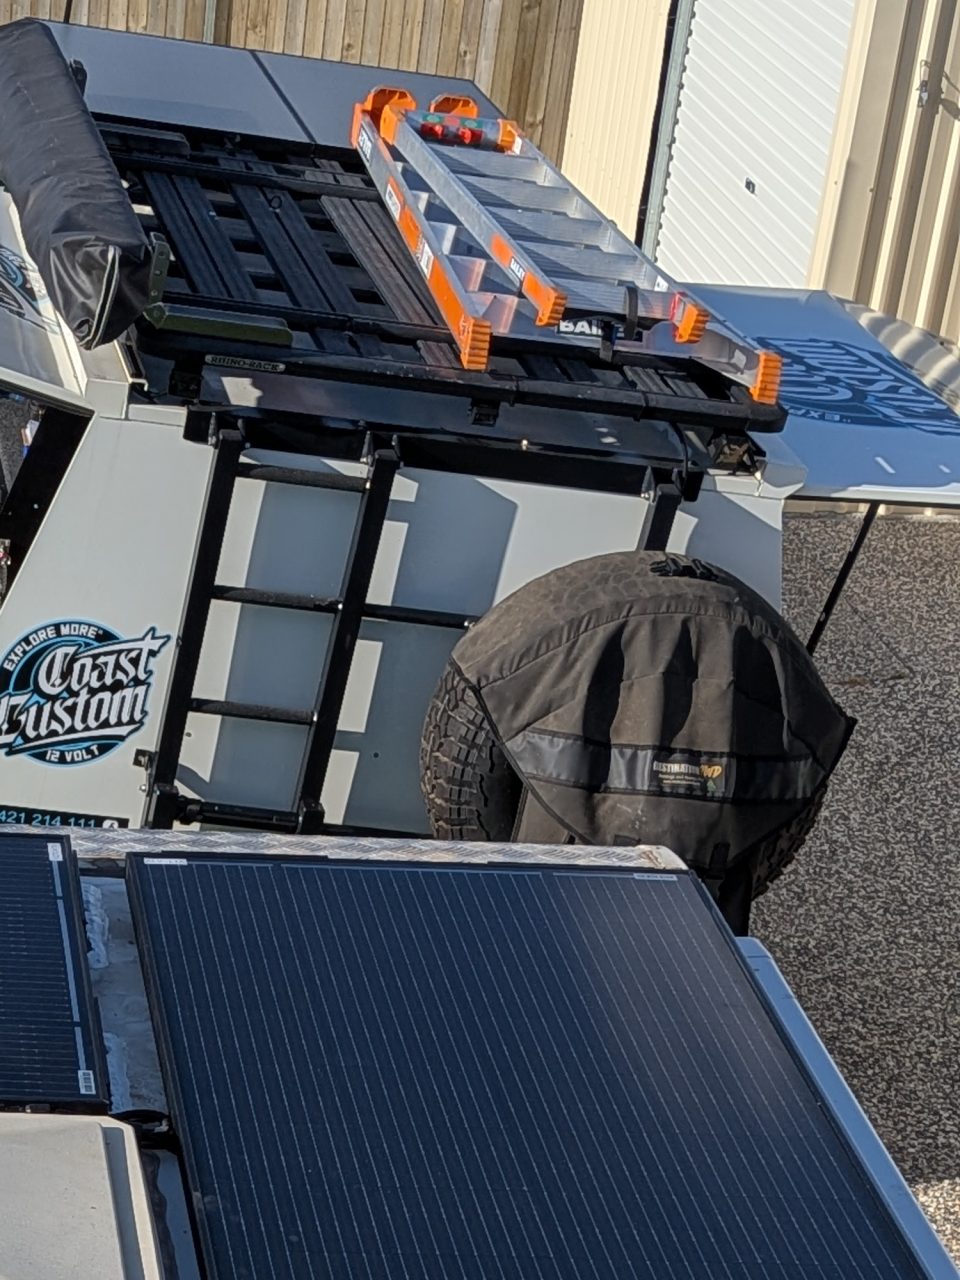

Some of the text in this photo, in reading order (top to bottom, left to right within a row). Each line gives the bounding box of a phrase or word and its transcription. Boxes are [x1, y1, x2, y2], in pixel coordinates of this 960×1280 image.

[2, 625, 57, 672] EXPLORE
[37, 626, 171, 696] Coast
[45, 744, 100, 763] 12 VOLT
[31, 813, 62, 828] 214
[67, 817, 96, 829] 111
